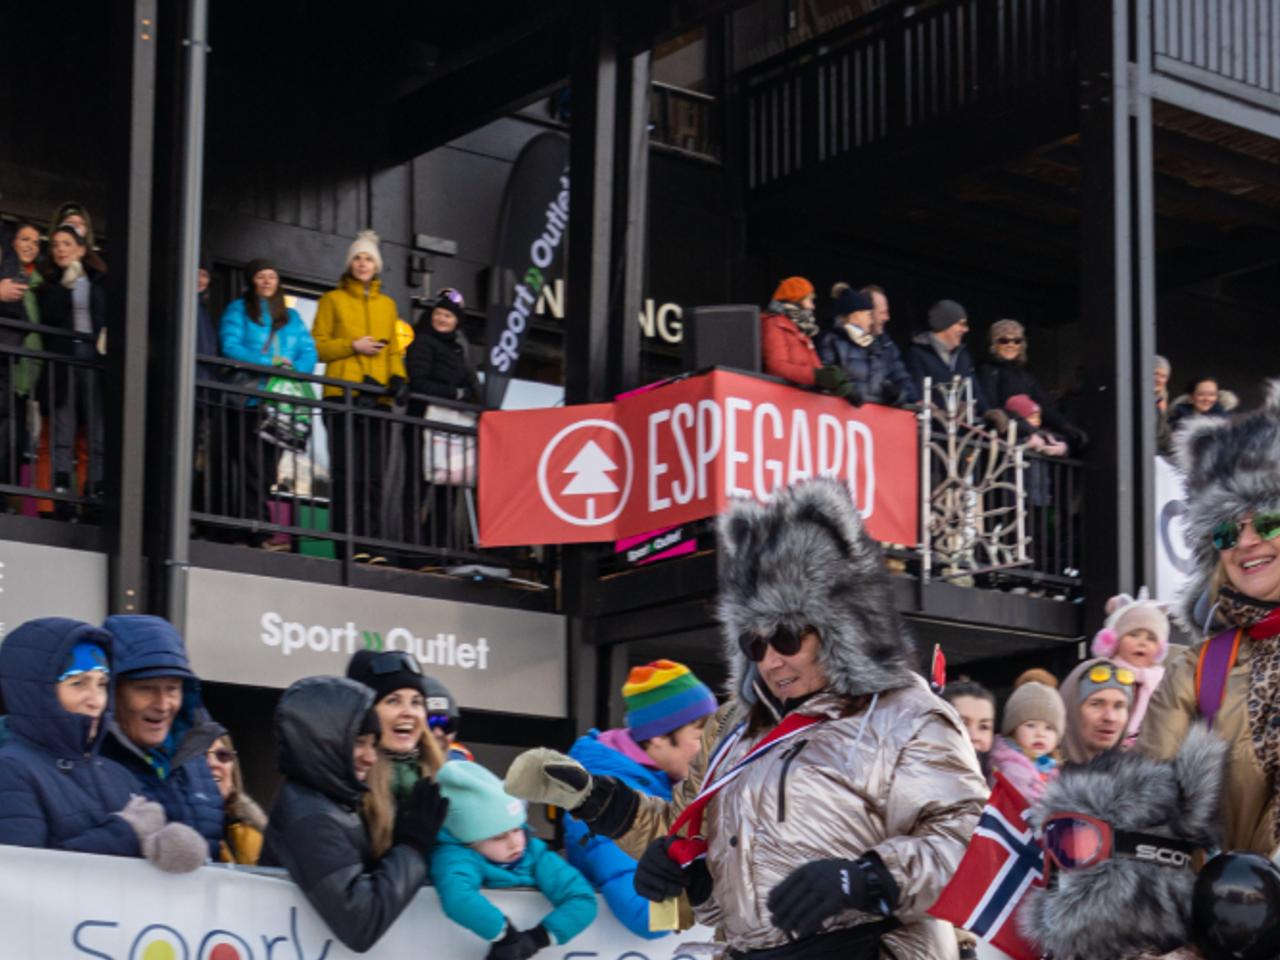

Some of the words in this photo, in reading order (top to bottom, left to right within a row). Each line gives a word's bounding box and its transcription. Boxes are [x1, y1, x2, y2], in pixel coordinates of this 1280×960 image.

[490, 284, 535, 372] Sport
[648, 397, 875, 520] ESPEGARD
[260, 611, 358, 655] Sport
[385, 627, 490, 670] Outlet
